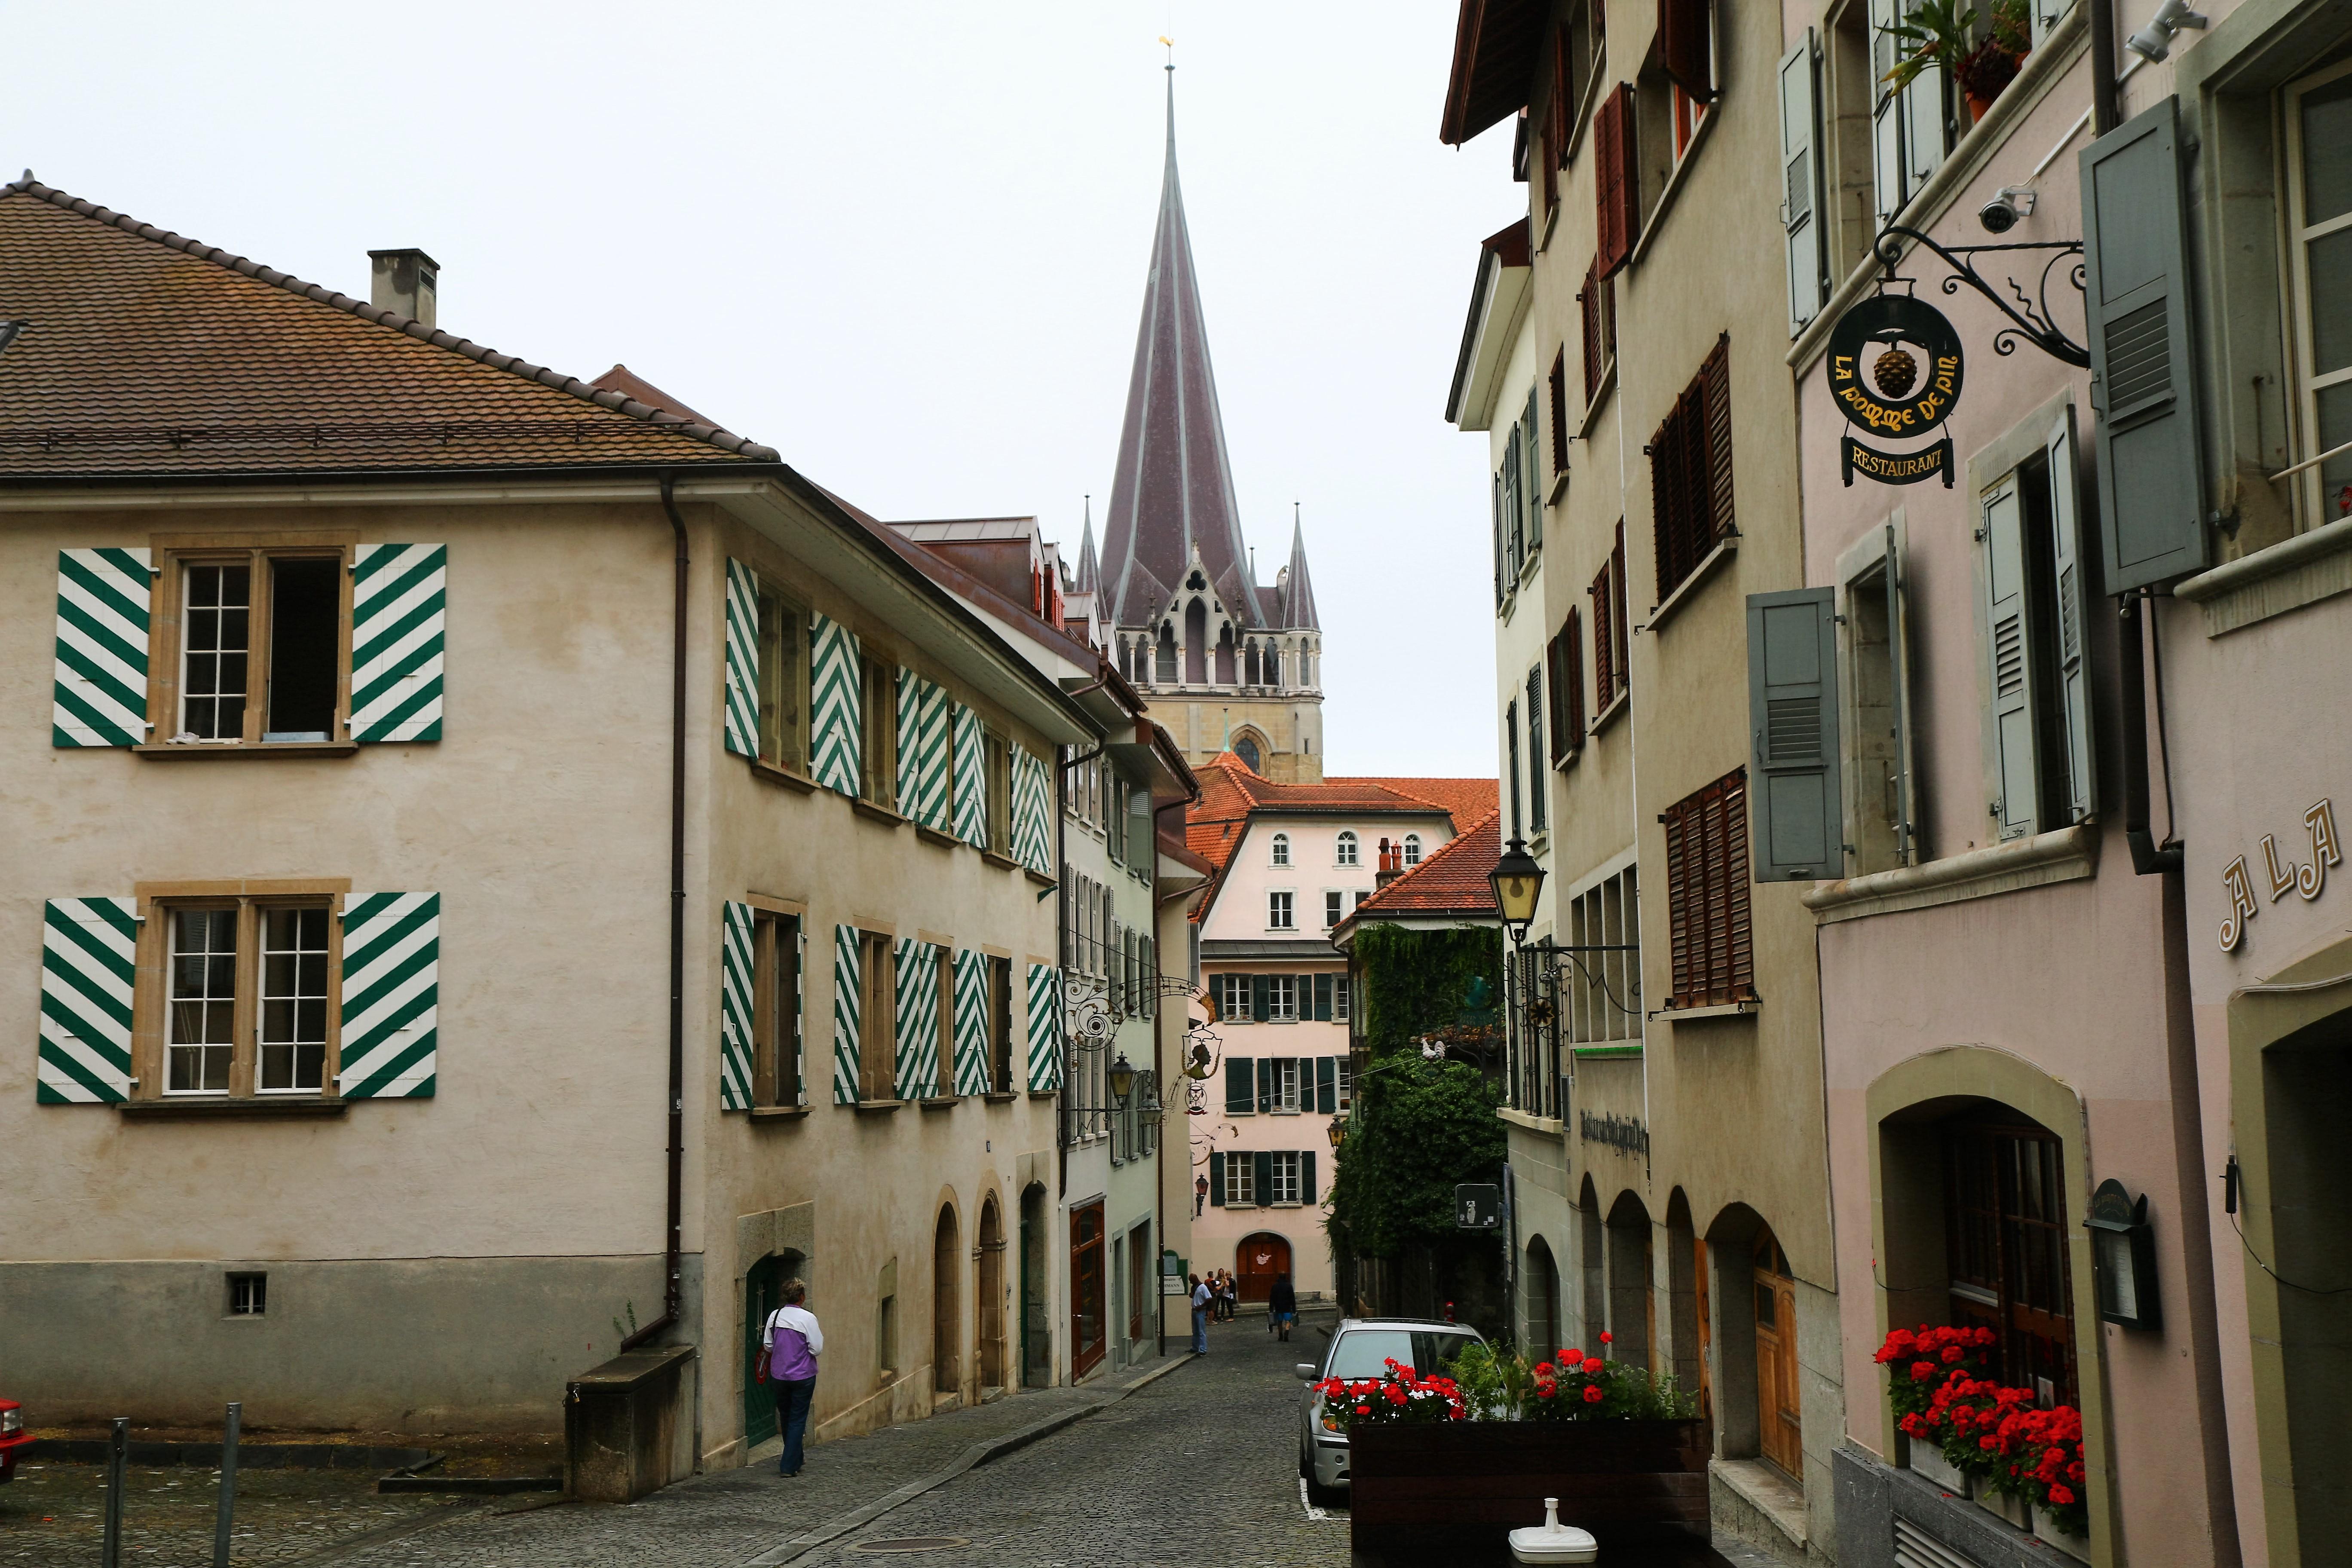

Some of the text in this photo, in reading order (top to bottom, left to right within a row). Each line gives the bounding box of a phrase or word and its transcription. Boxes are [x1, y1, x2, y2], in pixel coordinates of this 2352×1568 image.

[1835, 355, 1958, 432] LA POMME DE PIN
[1852, 445, 1942, 476] RESTAURANT
